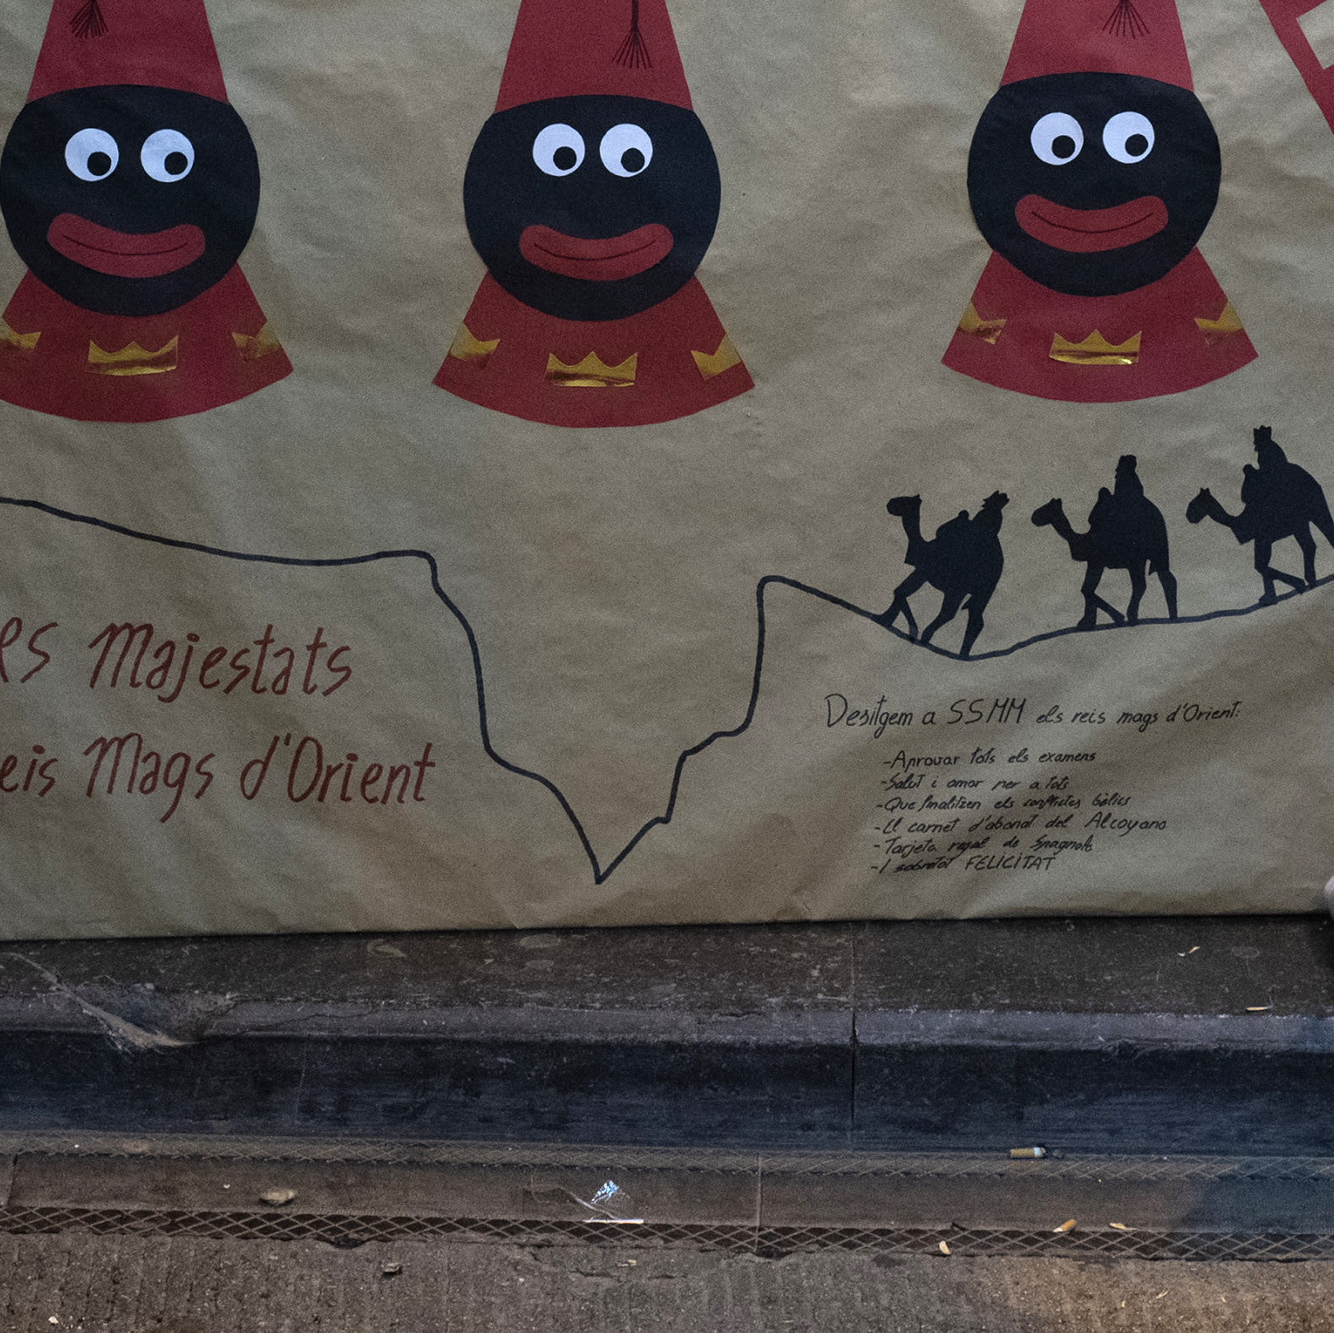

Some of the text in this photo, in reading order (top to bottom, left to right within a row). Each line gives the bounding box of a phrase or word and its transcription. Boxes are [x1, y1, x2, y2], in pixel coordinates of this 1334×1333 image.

[824, 693, 915, 739] Desitgem
[921, 710, 937, 726] a
[1035, 704, 1064, 724] els
[1070, 708, 1107, 725] reis
[1115, 711, 1159, 733] mags
[970, 747, 996, 765] tots
[1007, 747, 1029, 764] els
[1038, 751, 1097, 763] examens
[83, 732, 215, 823] Mags
[239, 732, 436, 804] d'Orient
[1029, 780, 1040, 790] a
[993, 796, 1015, 810] els
[907, 817, 961, 834] carnet
[1045, 813, 1074, 829] del
[1084, 811, 1167, 837] Alcoyano
